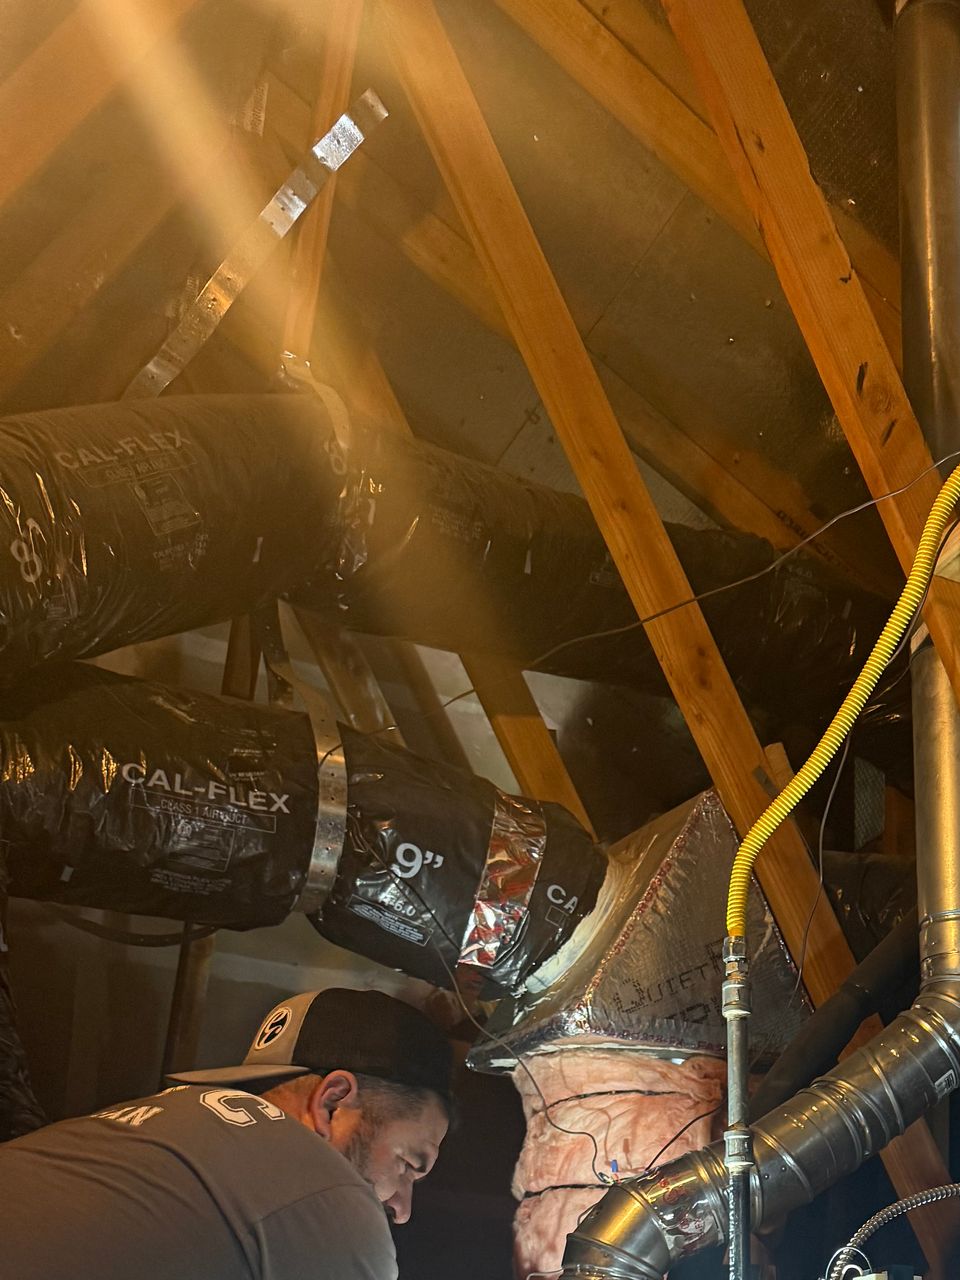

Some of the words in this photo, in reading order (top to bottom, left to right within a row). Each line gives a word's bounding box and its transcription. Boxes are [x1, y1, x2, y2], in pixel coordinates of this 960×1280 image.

[56, 430, 191, 469] CAL-FLEX
[121, 763, 291, 814] CAL-FLEX
[160, 799, 192, 814] CLASS
